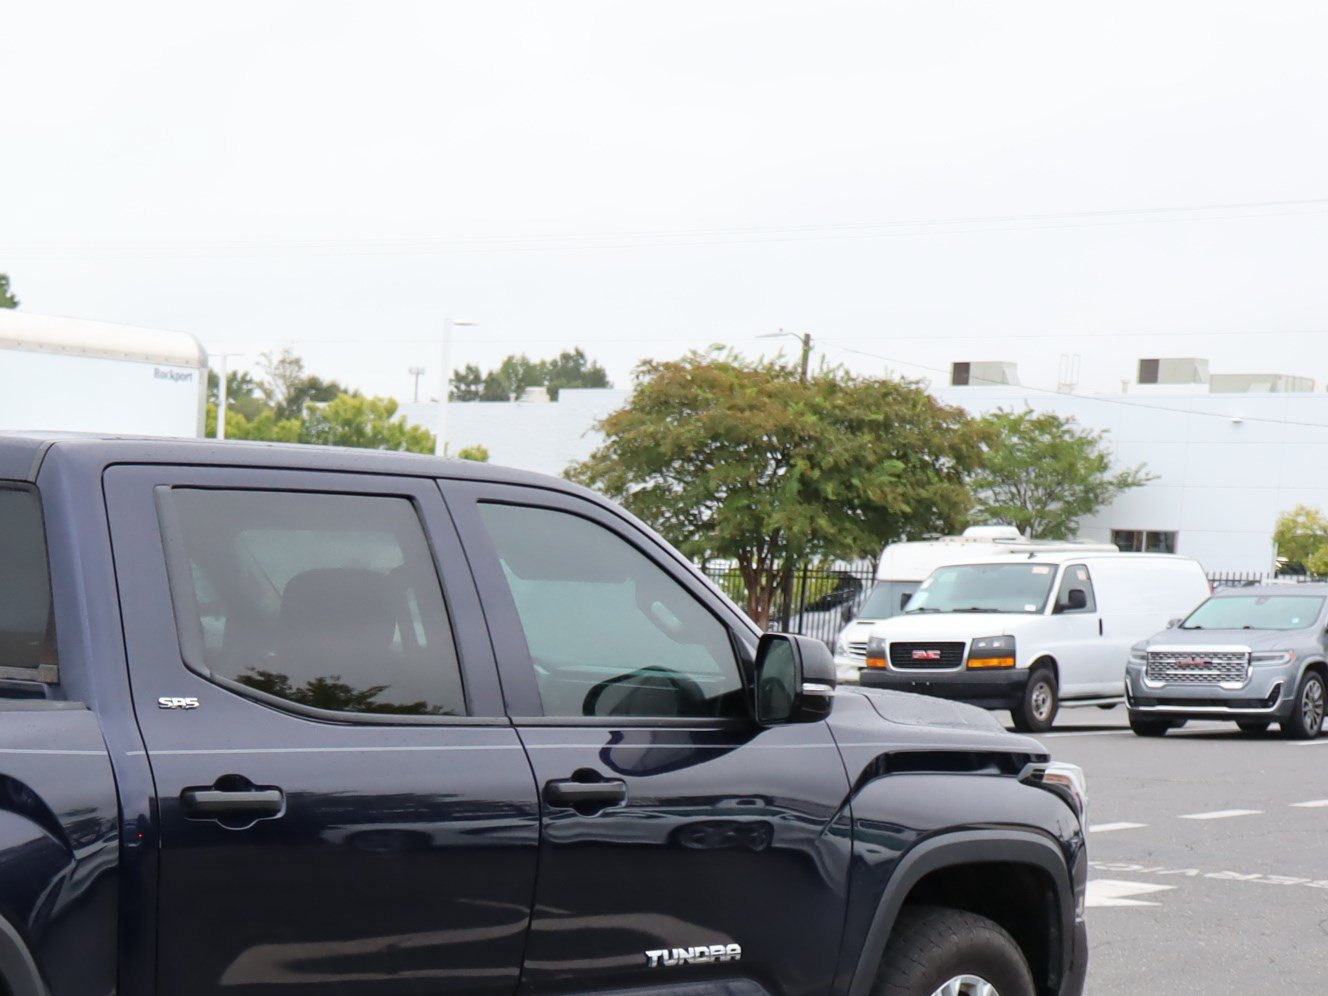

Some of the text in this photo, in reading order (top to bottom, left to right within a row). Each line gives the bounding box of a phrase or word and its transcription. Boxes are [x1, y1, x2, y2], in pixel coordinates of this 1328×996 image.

[912, 649, 941, 659] GMC
[158, 697, 200, 709] SR5
[645, 943, 742, 968] TUNDRA
